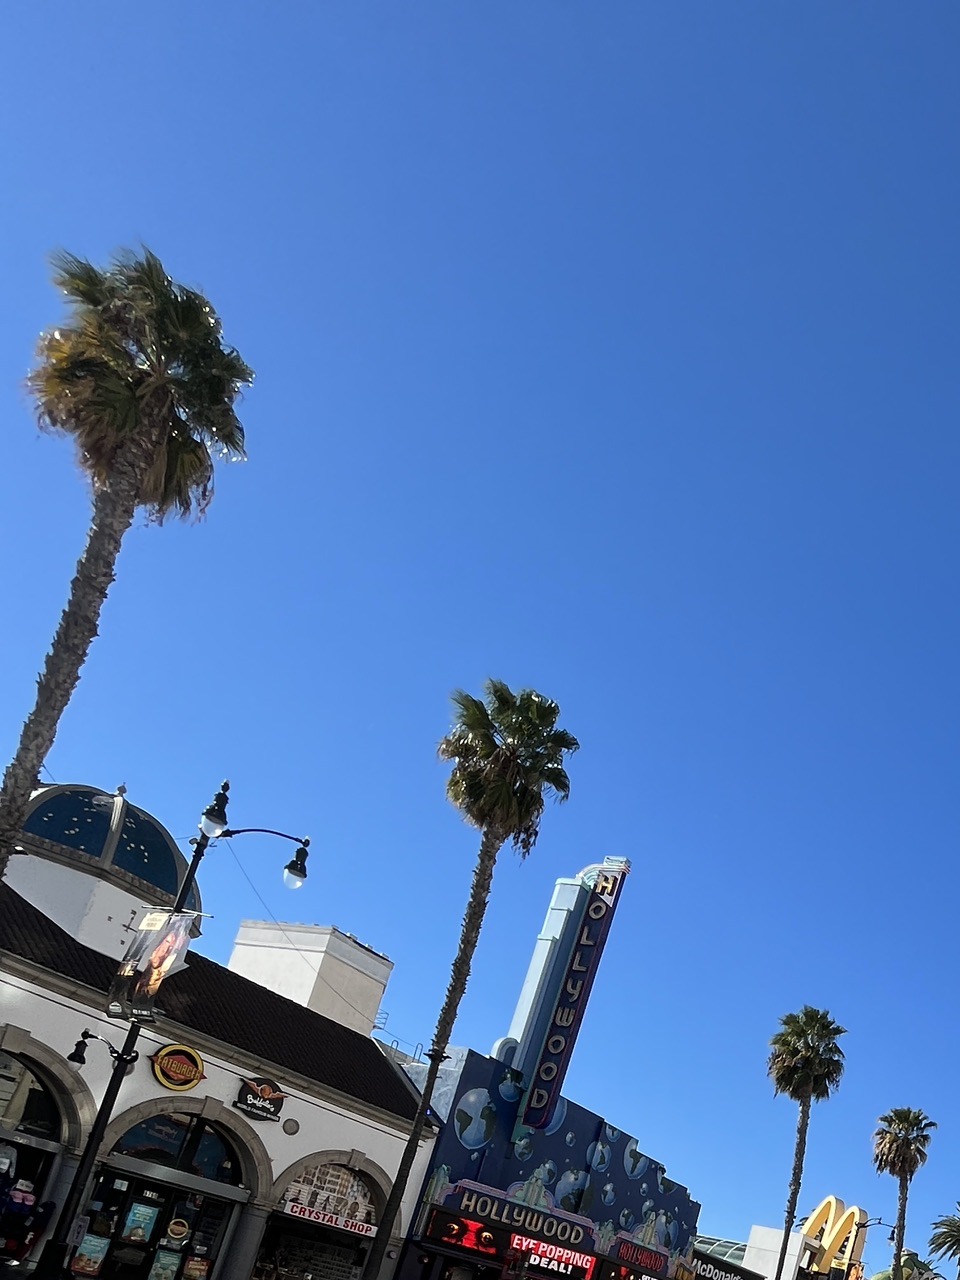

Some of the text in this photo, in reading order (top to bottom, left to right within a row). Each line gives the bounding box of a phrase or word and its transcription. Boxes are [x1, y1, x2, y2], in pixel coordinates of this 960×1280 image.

[530, 873, 619, 1109] HOLLYWOOD
[157, 1055, 202, 1080] FATBURGER
[290, 1204, 372, 1234] CRYSTAL SHOP
[460, 1191, 584, 1244] HOLLYWOOD
[512, 1235, 592, 1269] EYE POPPING
[529, 1254, 573, 1275] DEAL!
[618, 1241, 665, 1272] HOLLYWOOD
